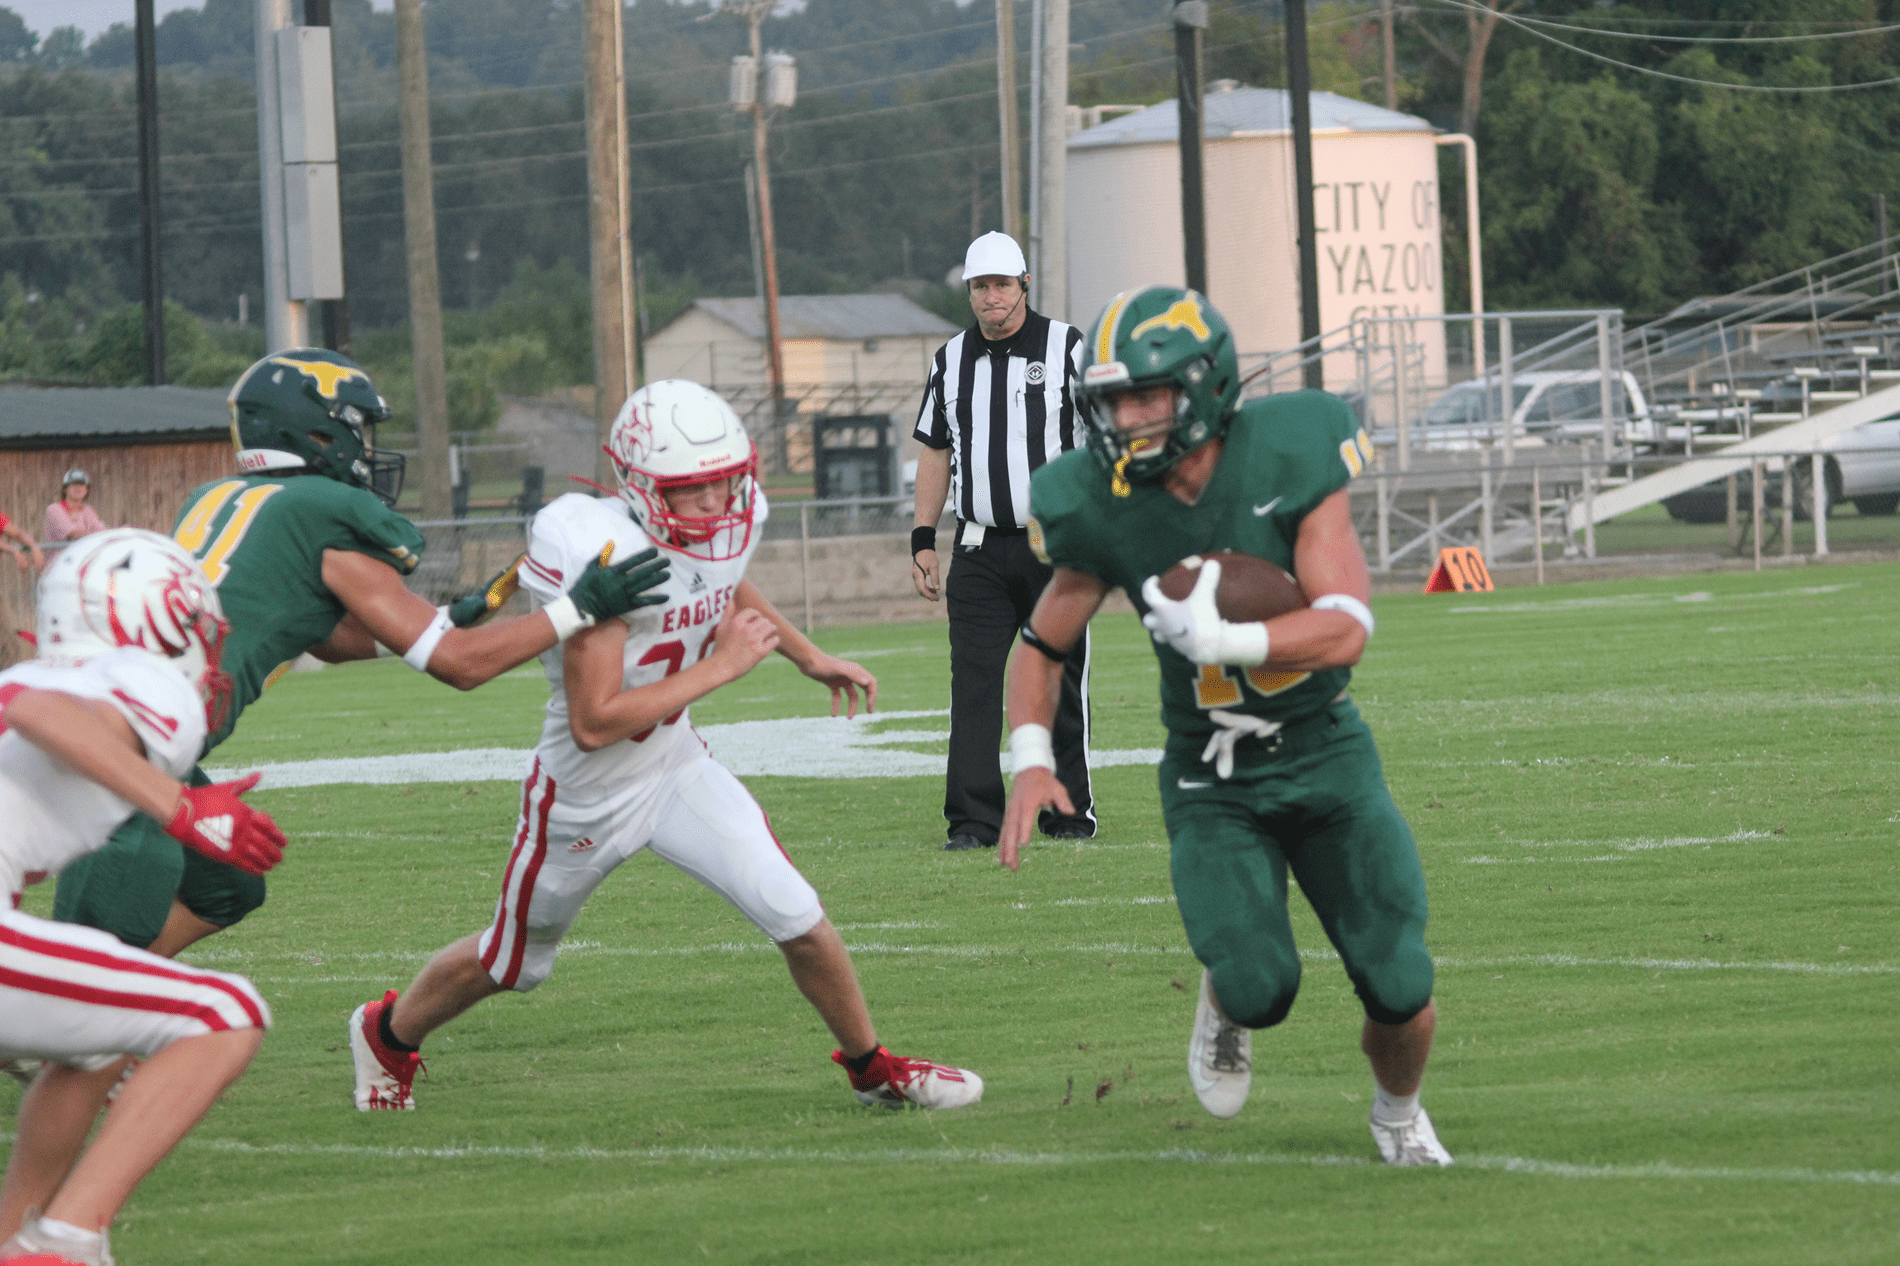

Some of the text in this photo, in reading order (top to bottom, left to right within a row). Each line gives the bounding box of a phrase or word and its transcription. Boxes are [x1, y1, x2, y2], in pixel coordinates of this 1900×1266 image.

[1311, 180, 1434, 232] CITY OF
[1326, 243, 1434, 295] YAZOO
[1350, 304, 1420, 354] CITY
[172, 480, 286, 588] 41
[1452, 550, 1486, 590] 10
